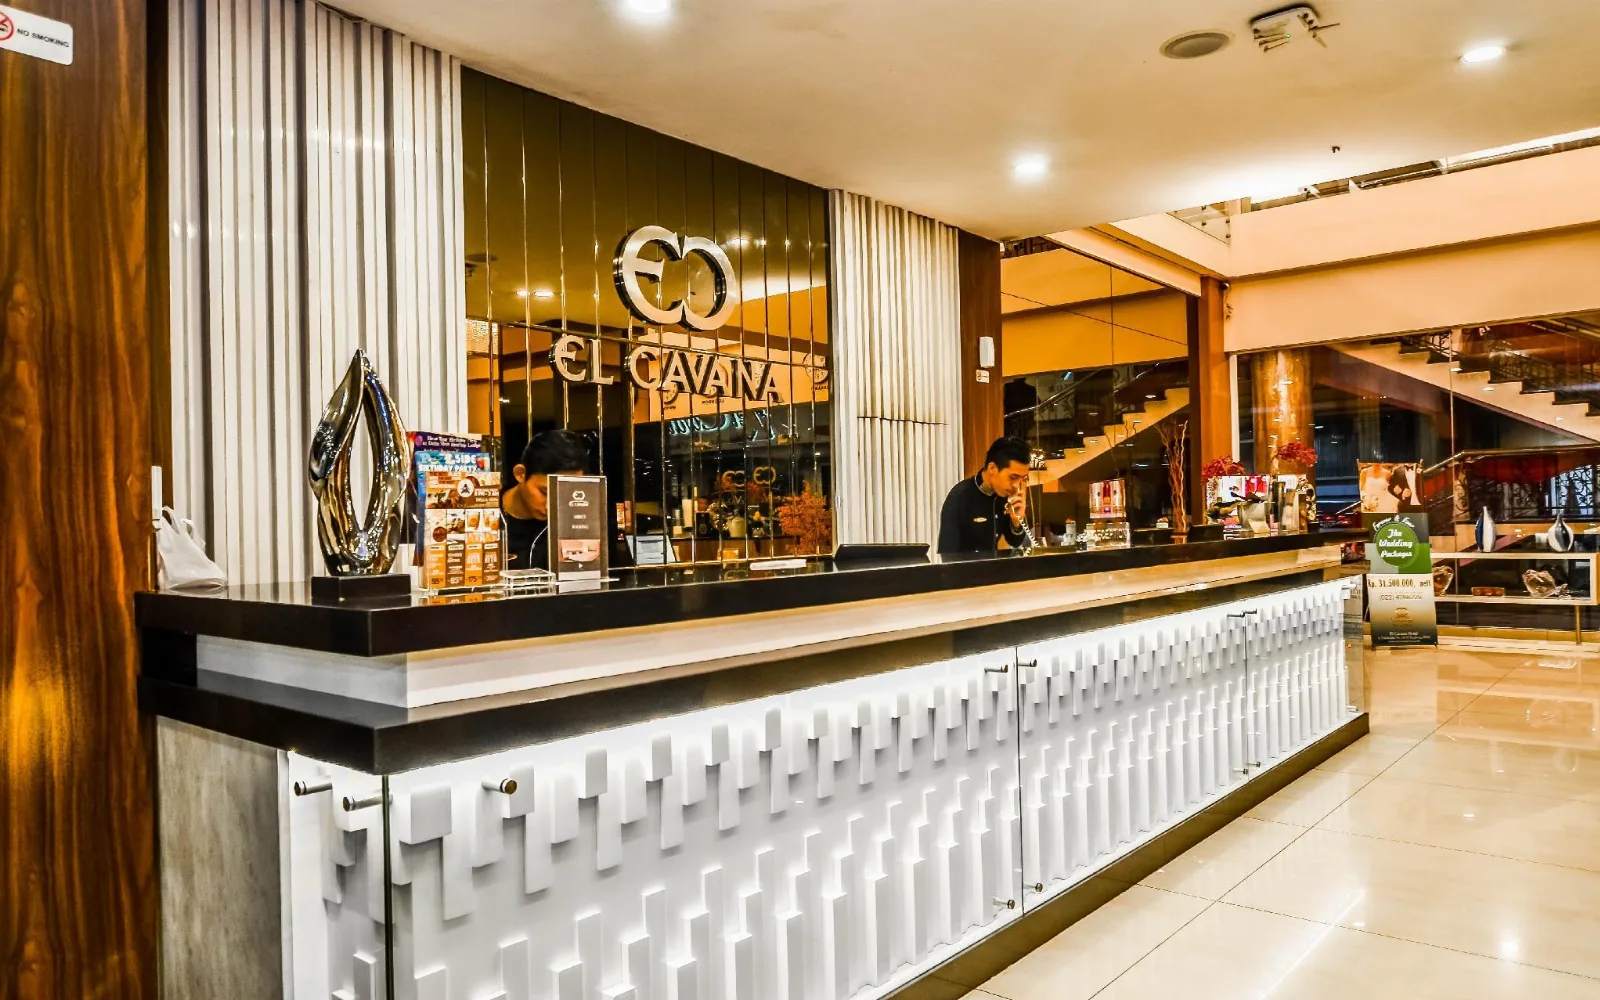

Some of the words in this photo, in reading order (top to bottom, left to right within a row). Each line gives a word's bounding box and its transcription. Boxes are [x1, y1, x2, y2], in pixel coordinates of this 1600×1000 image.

[17, 28, 30, 37] NO
[31, 32, 70, 48] SMOKING
[549, 334, 615, 387] EL
[624, 343, 785, 404] CAVANA
[1387, 528, 1403, 538] The
[1379, 539, 1413, 548] Wedding
[1380, 550, 1413, 558] Packages
